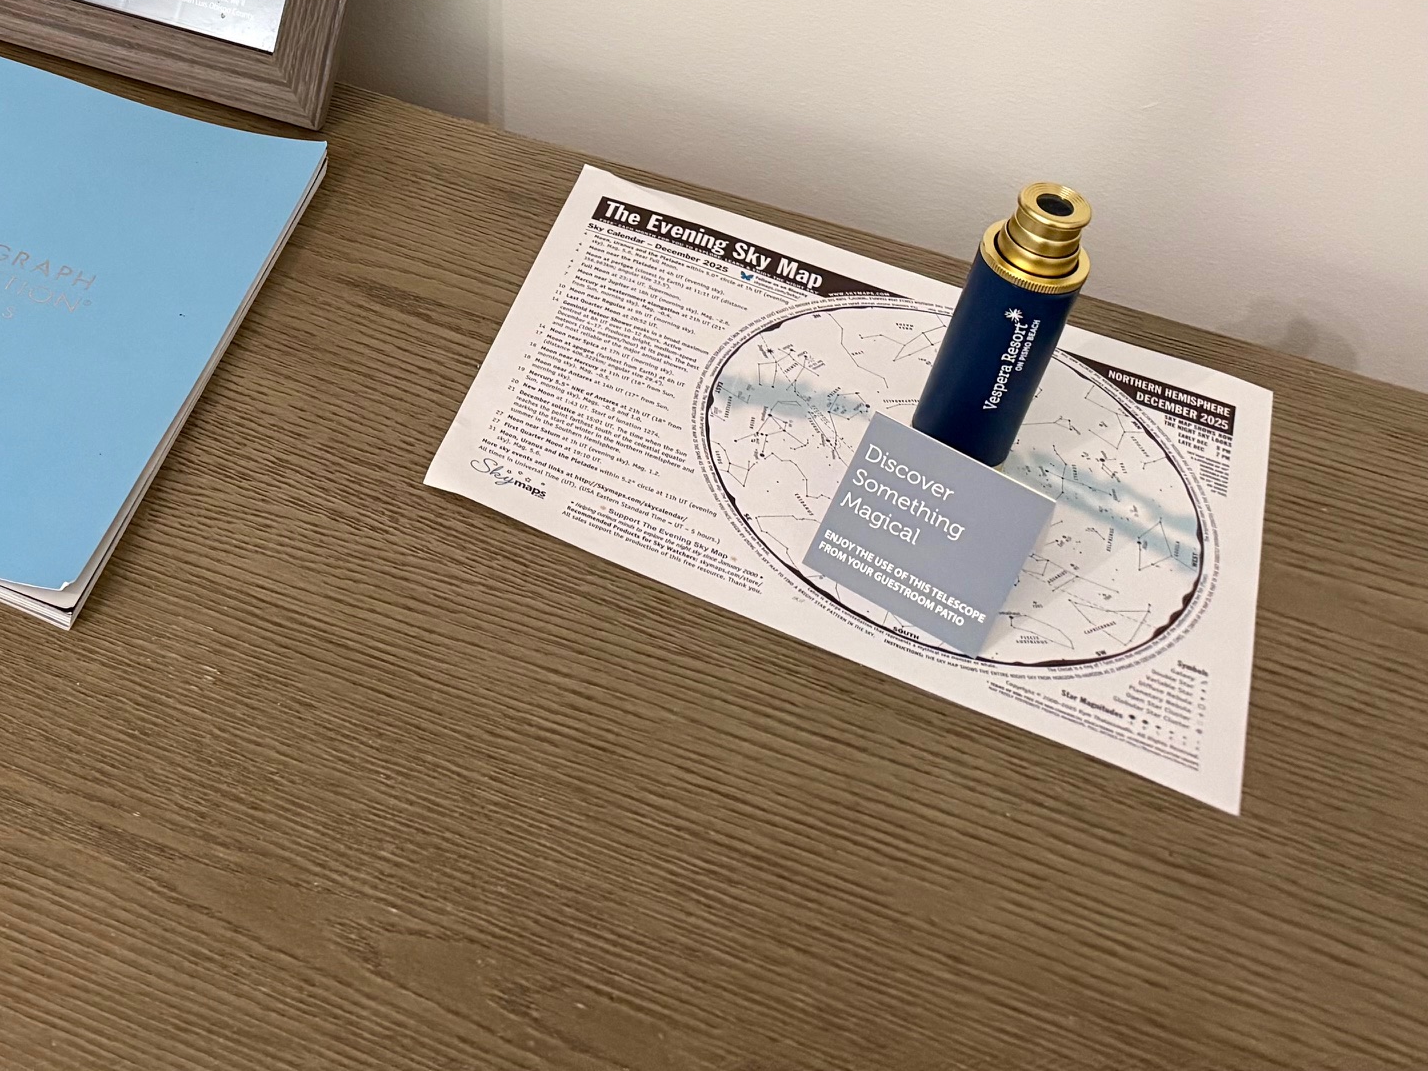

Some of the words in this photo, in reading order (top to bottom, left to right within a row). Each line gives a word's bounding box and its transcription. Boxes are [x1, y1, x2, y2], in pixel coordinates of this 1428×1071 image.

[587, 222, 605, 232] Sky
[606, 228, 646, 244] Calendar
[654, 243, 701, 263] December
[702, 259, 729, 273] 2025
[604, 200, 641, 225] The
[645, 213, 730, 256] Evening
[732, 242, 772, 271] Sky
[776, 257, 823, 289] Map
[1018, 341, 1032, 362] PISMO
[1026, 319, 1041, 342] BEACH
[982, 364, 1013, 410] Vespera
[1001, 322, 1028, 364] Resort
[1015, 361, 1025, 372] ON
[1108, 369, 1163, 395] NORTHERN
[1164, 387, 1231, 418] HEMISPHERE
[1136, 391, 1198, 420] DECEMBER
[1199, 412, 1229, 430] 2025
[1164, 414, 1176, 423] SKY
[1178, 418, 1192, 428] MAP
[1194, 424, 1216, 436] SHOWS
[1218, 433, 1233, 441] HOW
[1164, 420, 1175, 428] THE
[1177, 424, 1196, 435] NIGHT
[1197, 431, 1209, 440] SKY
[1211, 437, 1232, 447] LOOKS
[864, 443, 955, 501] Discover
[839, 491, 921, 546] Magical
[852, 468, 966, 541] Something
[818, 540, 848, 563] FROM
[847, 555, 875, 577] YOUR
[873, 571, 936, 611] GUESTROOM
[934, 604, 965, 627] PATIO
[824, 529, 856, 552] ENJOY
[855, 545, 875, 563] THE
[874, 556, 895, 574] USE
[893, 567, 909, 580] OF
[908, 574, 932, 594] THIS
[931, 586, 987, 624] TELESCOPE
[892, 626, 920, 640] SOUTH
